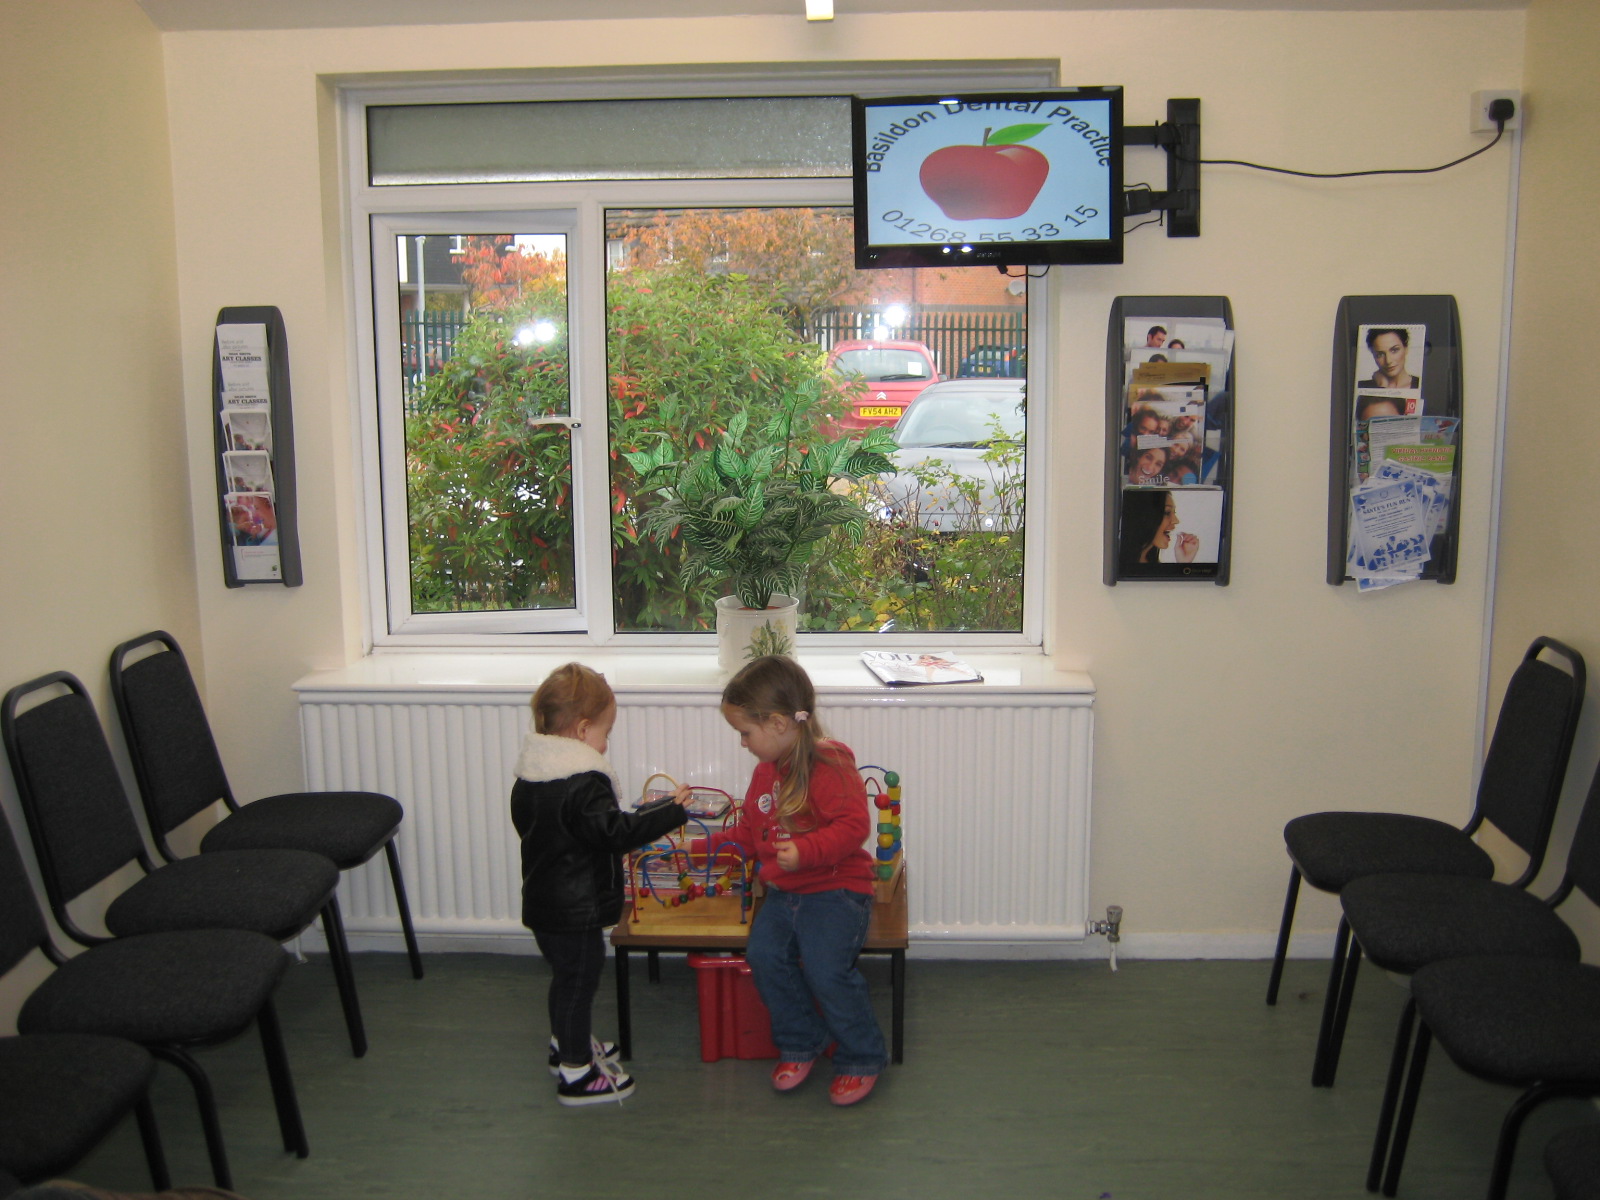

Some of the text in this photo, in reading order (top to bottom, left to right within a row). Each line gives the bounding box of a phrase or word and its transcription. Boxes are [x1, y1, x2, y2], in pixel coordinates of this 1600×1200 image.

[866, 100, 1111, 173] Basildon Dental Practice
[882, 209, 966, 243] 01268
[1022, 223, 1060, 241] 33
[1064, 204, 1099, 228] 15
[1138, 475, 1170, 485] Smile
